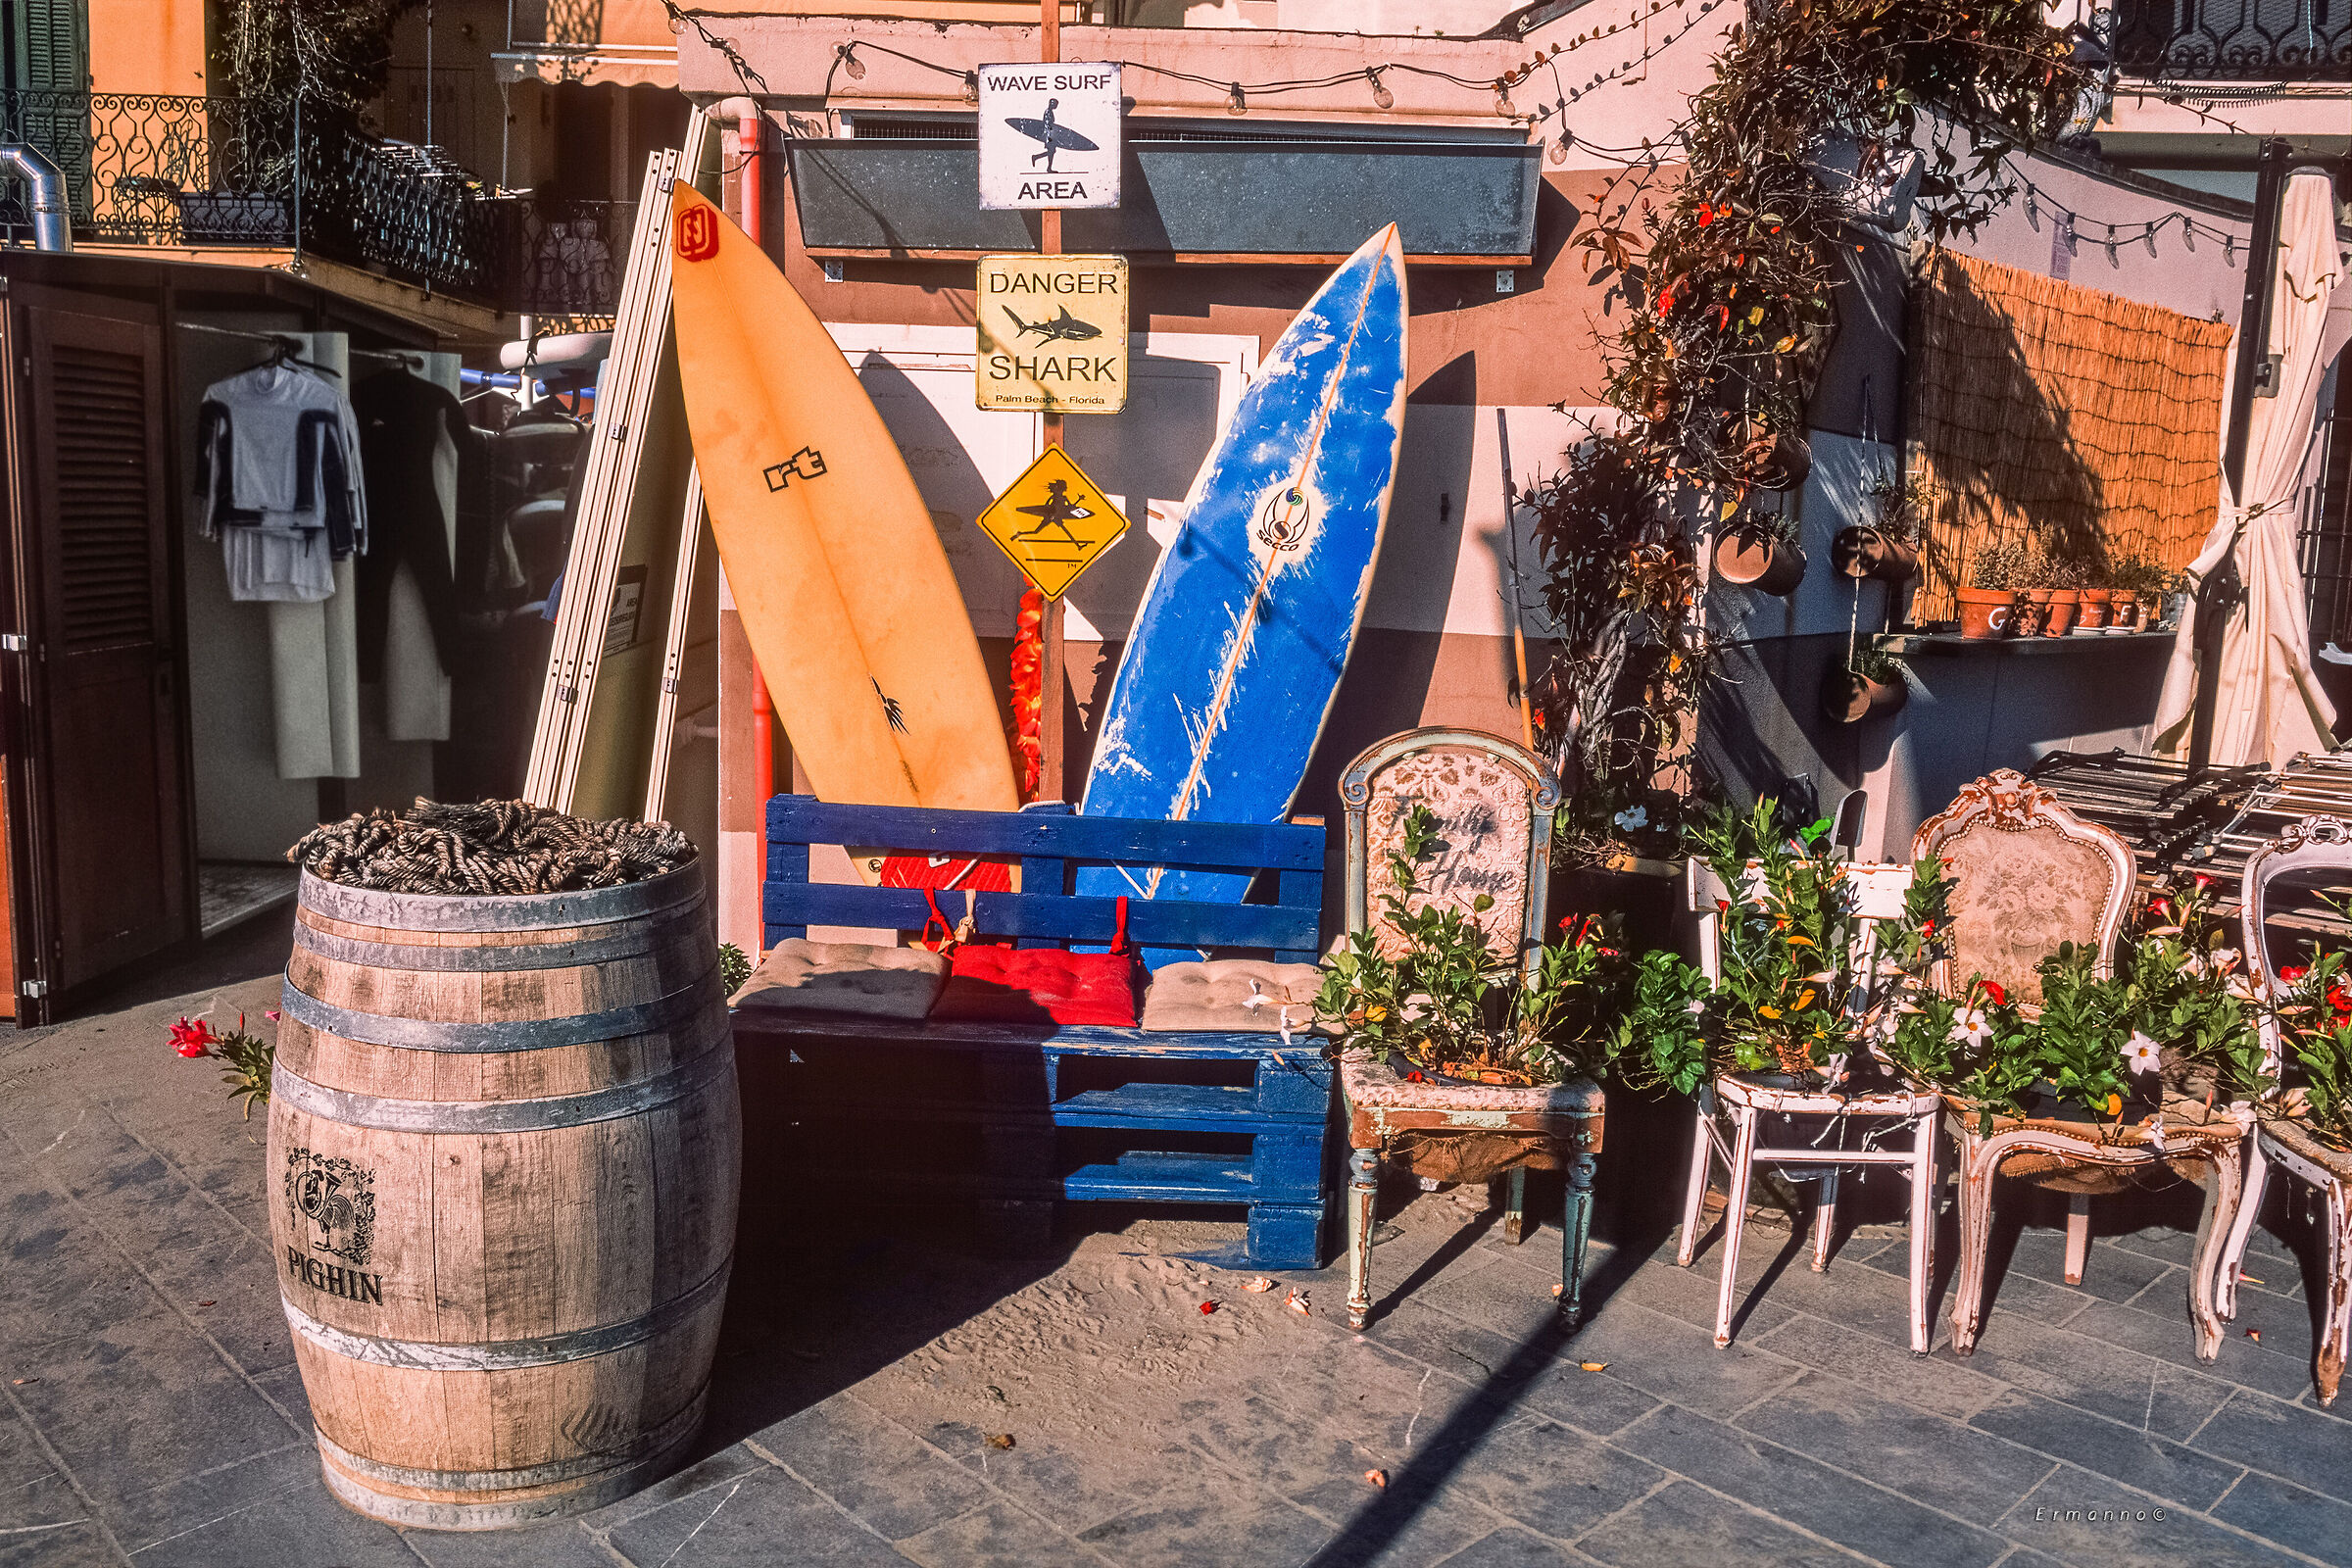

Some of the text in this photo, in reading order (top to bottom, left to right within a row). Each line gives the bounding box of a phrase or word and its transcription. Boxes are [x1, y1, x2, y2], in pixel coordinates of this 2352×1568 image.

[988, 74, 1112, 91] WAVE SURF
[1017, 181, 1088, 200] AREA
[990, 272, 1118, 294] DANGER
[988, 355, 1117, 382] SHARK
[995, 394, 1022, 404] Palm
[1024, 395, 1058, 404] Beach
[1069, 395, 1105, 405] Florida
[1987, 607, 2007, 631] G
[287, 1245, 384, 1306] PIGHIN
